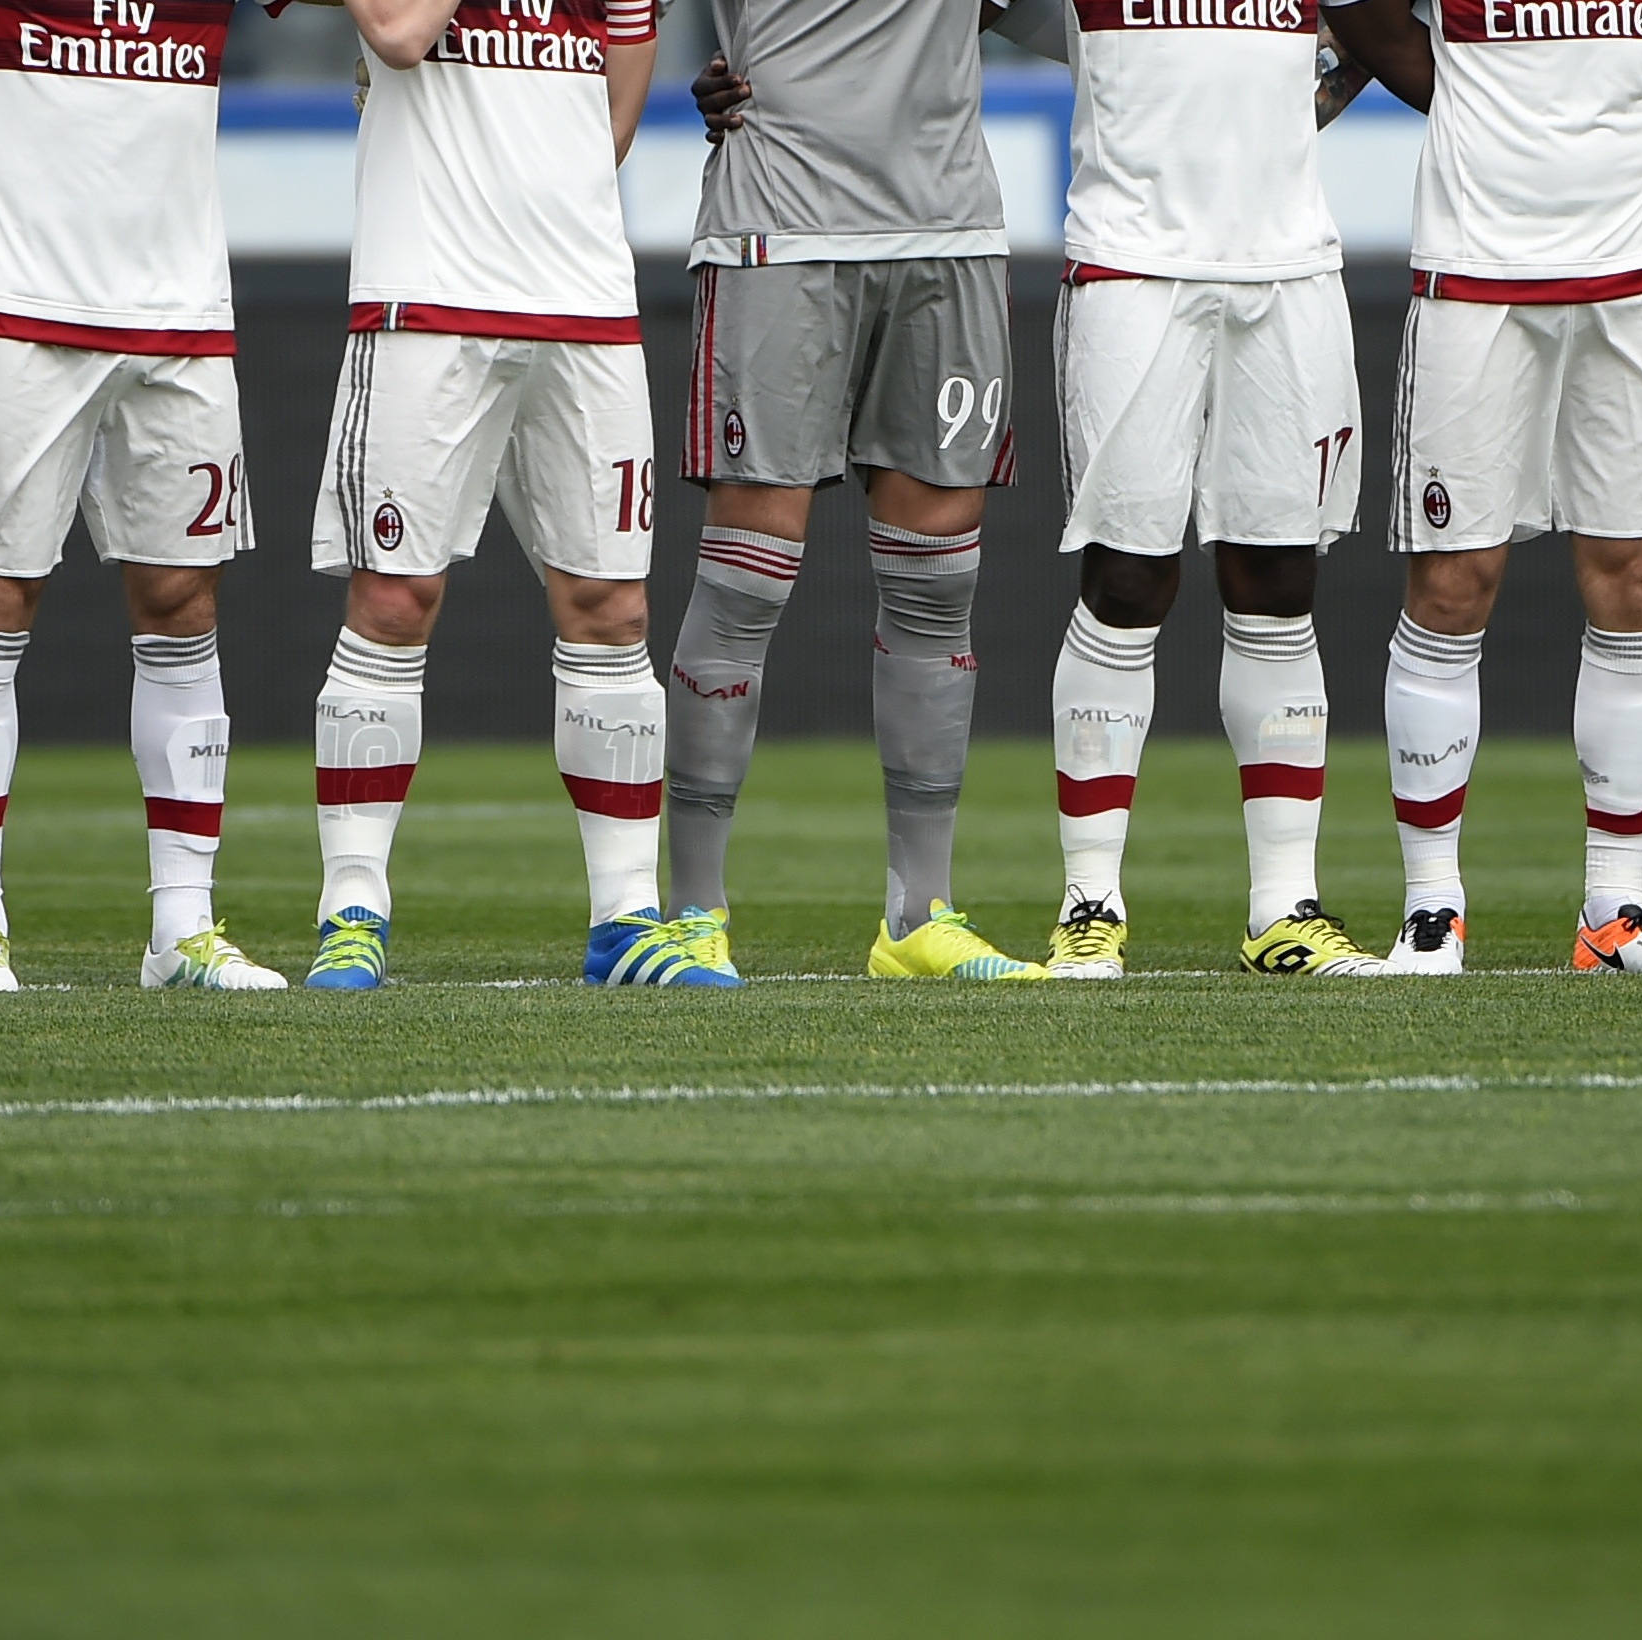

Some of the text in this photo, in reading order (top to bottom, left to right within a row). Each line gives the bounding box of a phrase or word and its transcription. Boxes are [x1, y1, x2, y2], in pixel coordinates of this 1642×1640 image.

[19, 22, 206, 80] Emirates
[437, 20, 605, 72] Emirates
[937, 376, 1003, 451] 99
[1314, 426, 1353, 509] 17
[611, 458, 654, 534] 18
[673, 663, 751, 701] MILAN
[317, 704, 386, 722] MILAN
[565, 708, 656, 736] MILAN
[1070, 708, 1146, 729] MILAN
[1283, 705, 1327, 717] MIL
[189, 744, 228, 759] MIL
[1399, 736, 1469, 766] MILAN
